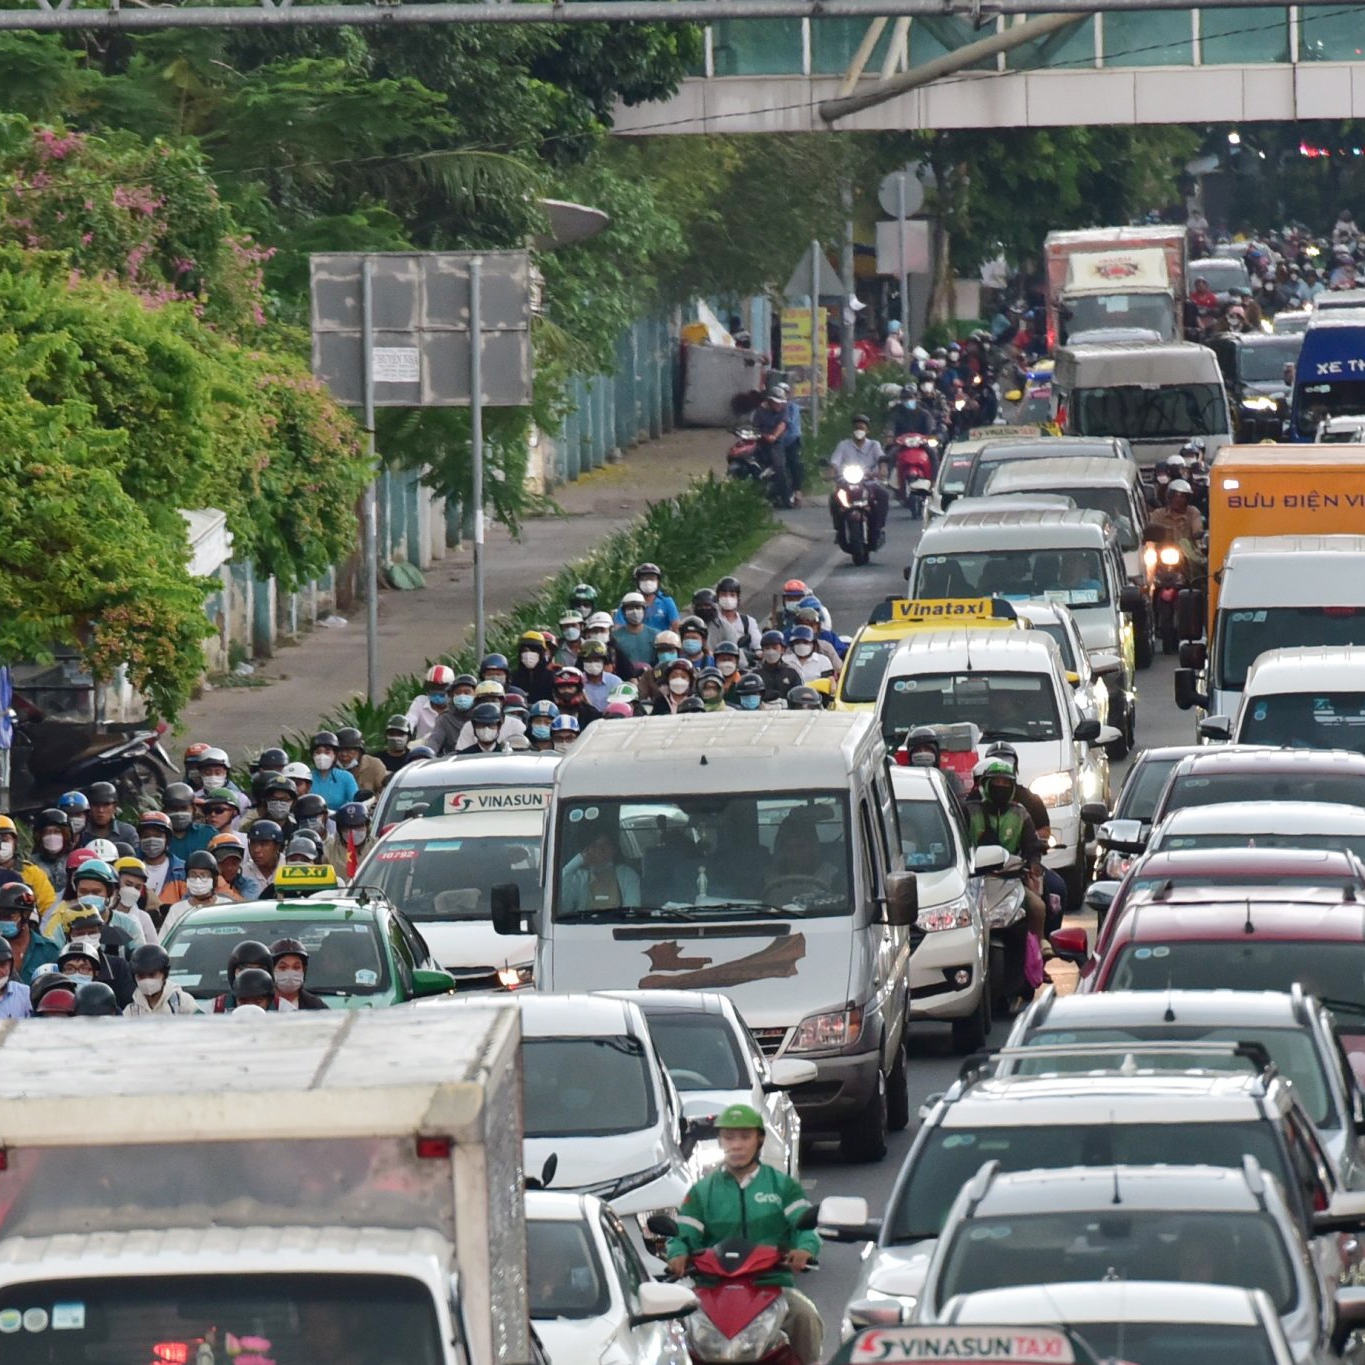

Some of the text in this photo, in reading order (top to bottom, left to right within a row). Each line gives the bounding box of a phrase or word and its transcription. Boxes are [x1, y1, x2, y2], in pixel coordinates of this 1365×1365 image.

[1316, 361, 1342, 375] XE
[1227, 492, 1276, 508] BƯU
[1283, 490, 1339, 513] ĐIỆN
[900, 601, 985, 616] Vinataxi
[477, 793, 543, 808] VINASUN
[898, 1336, 1063, 1357] VINASUN TAXI
